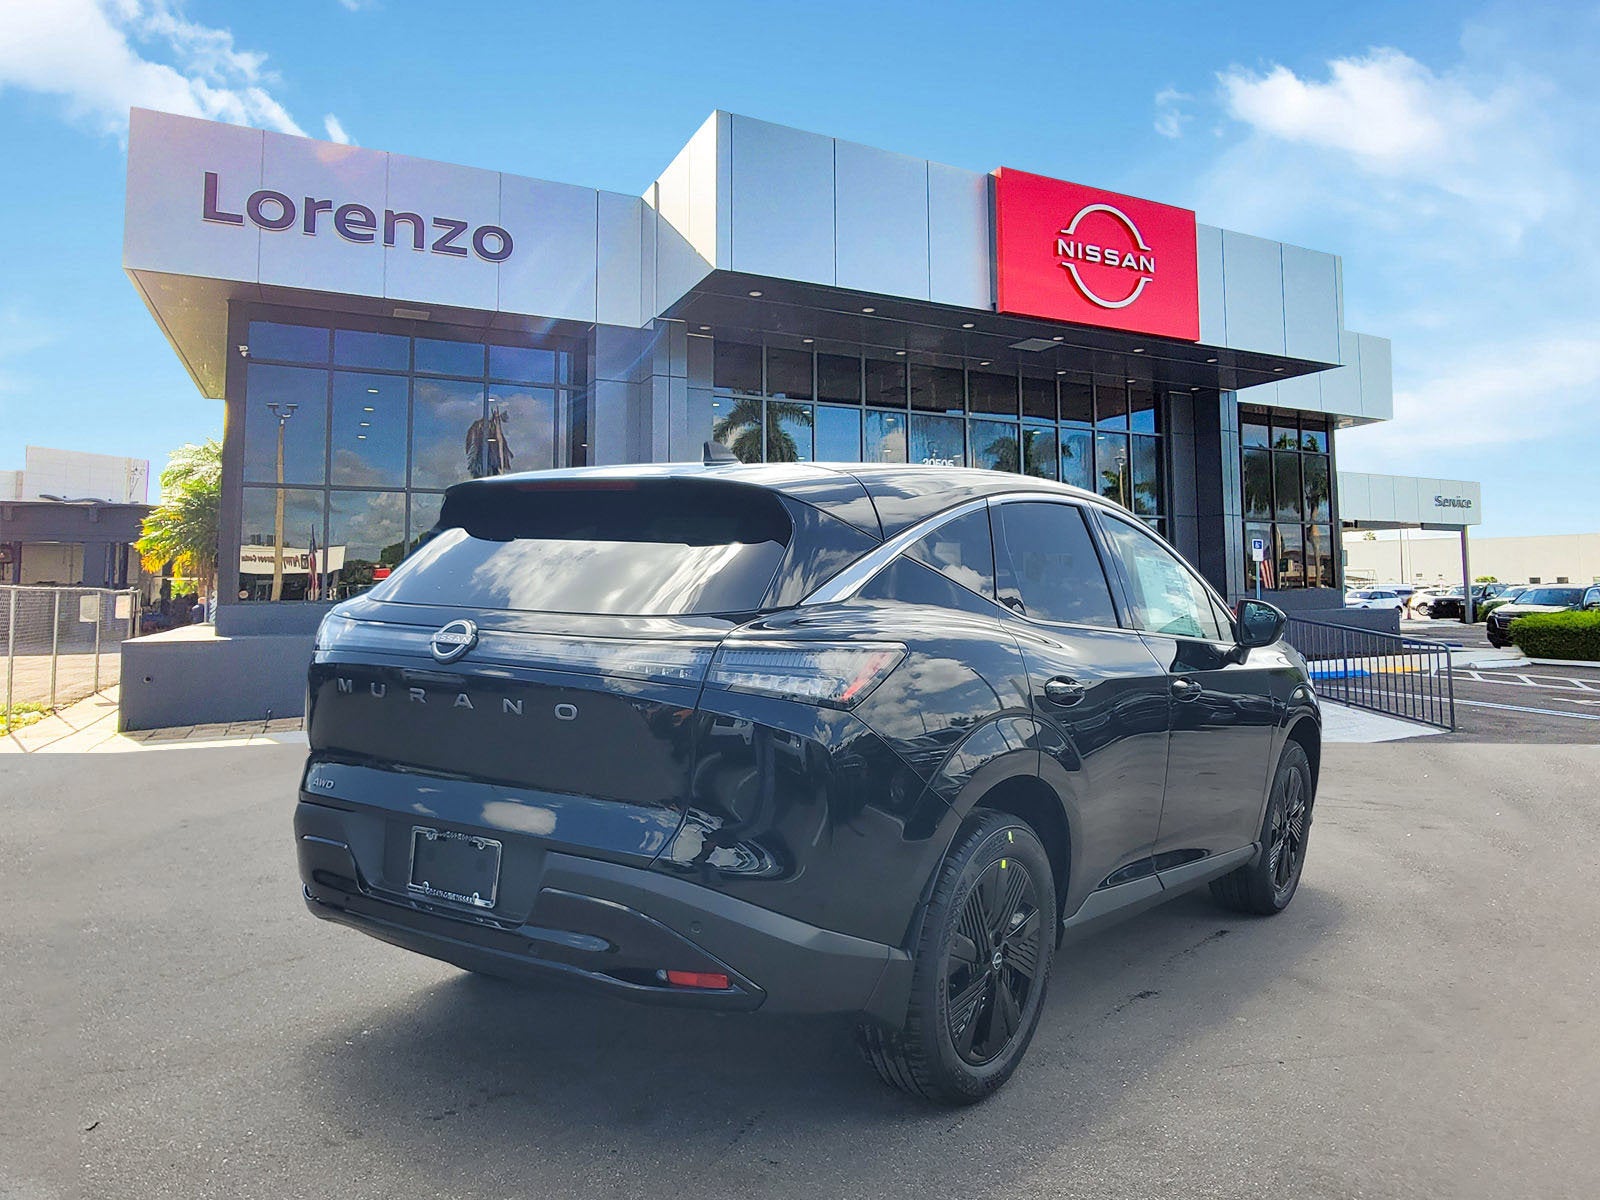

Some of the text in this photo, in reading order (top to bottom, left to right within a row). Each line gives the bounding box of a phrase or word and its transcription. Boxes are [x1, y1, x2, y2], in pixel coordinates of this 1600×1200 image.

[202, 171, 514, 262] Lorenzo
[1057, 238, 1155, 273] NISSAN
[1434, 495, 1472, 508] Service
[337, 677, 579, 722] MURANO
[312, 777, 335, 790] AWD
